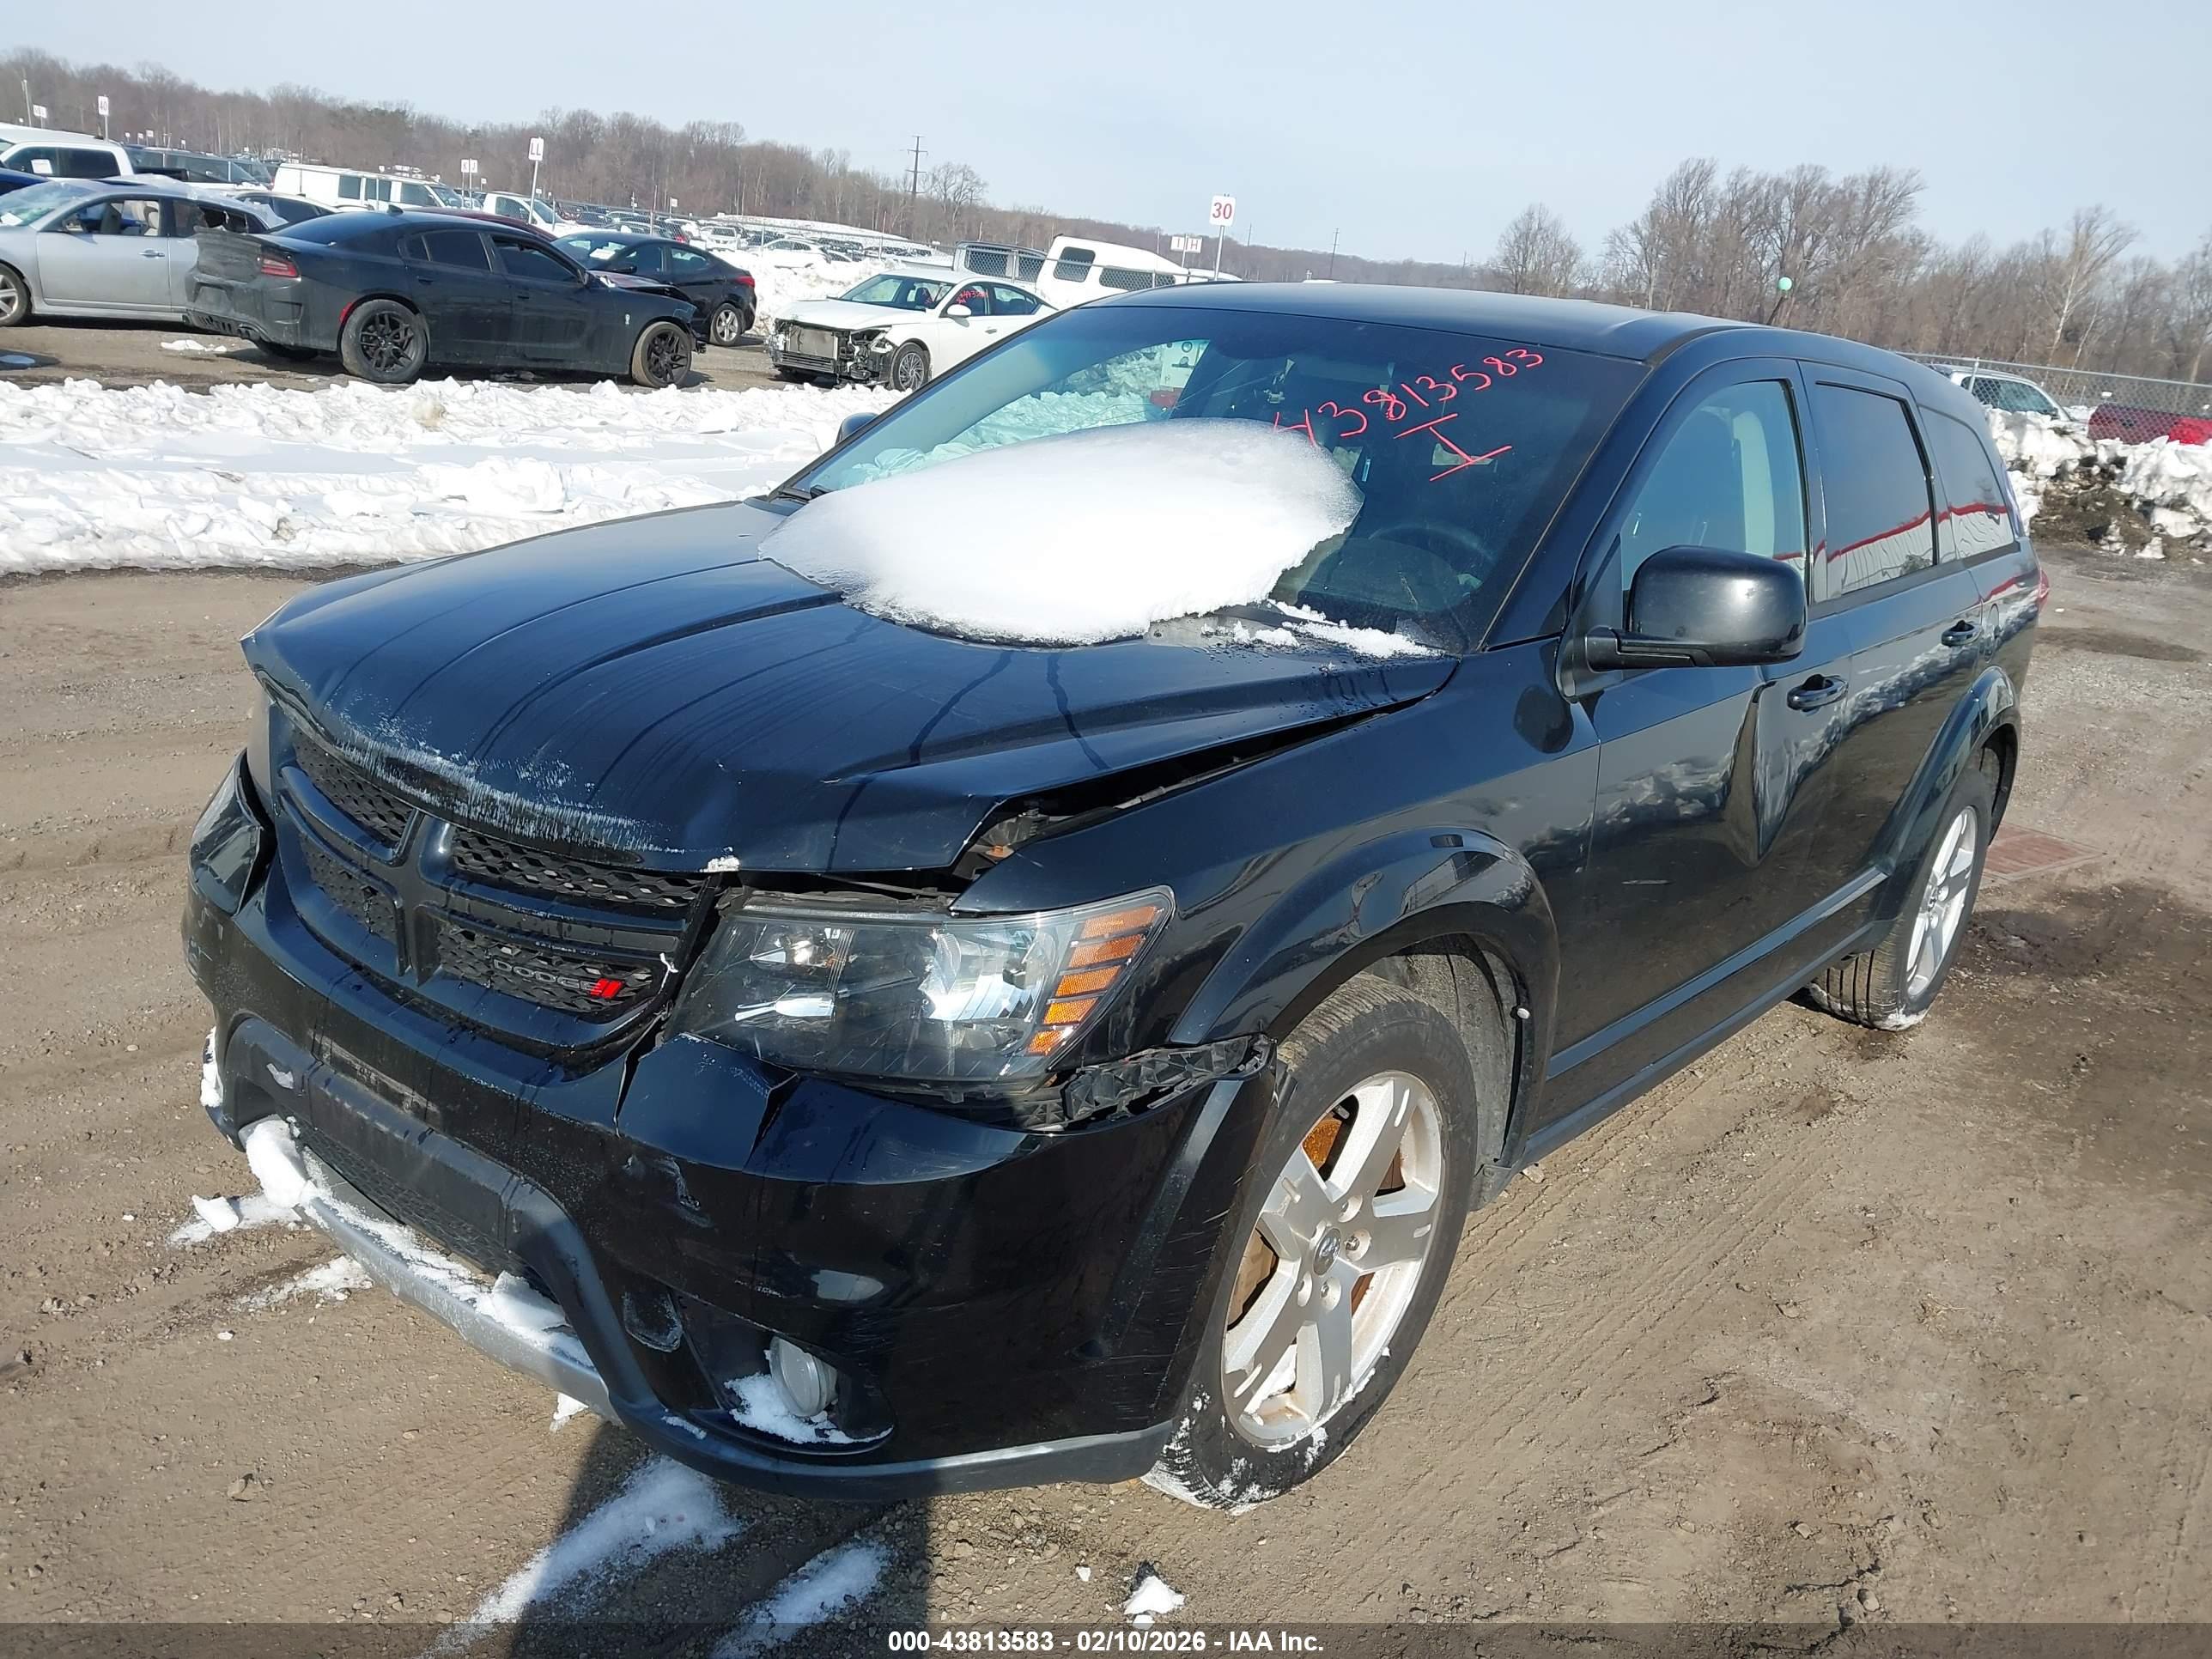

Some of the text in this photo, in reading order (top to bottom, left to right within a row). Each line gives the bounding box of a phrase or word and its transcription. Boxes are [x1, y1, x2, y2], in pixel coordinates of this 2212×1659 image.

[1212, 202, 1233, 220] 30
[1189, 239, 1199, 251] H
[493, 958, 603, 994] DODGE
